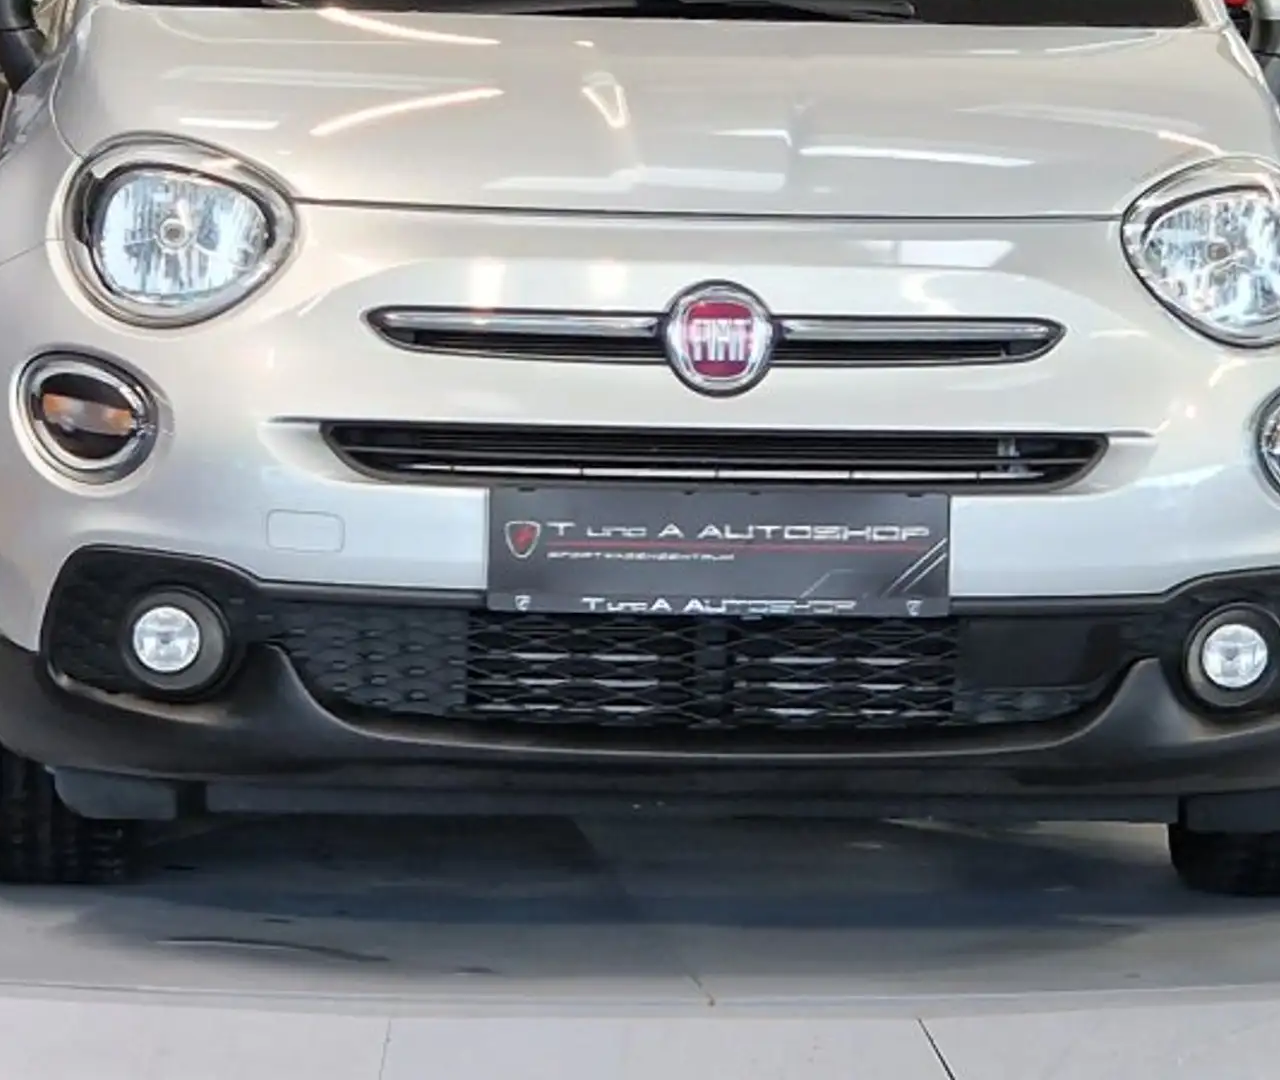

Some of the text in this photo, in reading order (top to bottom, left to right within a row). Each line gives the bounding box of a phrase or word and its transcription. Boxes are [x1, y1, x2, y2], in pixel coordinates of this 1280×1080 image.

[689, 318, 751, 361] FIAT
[546, 522, 575, 536] T
[658, 524, 685, 538] A
[697, 524, 930, 541] AUTOSHOP
[682, 598, 857, 614] AUTOSHOP
